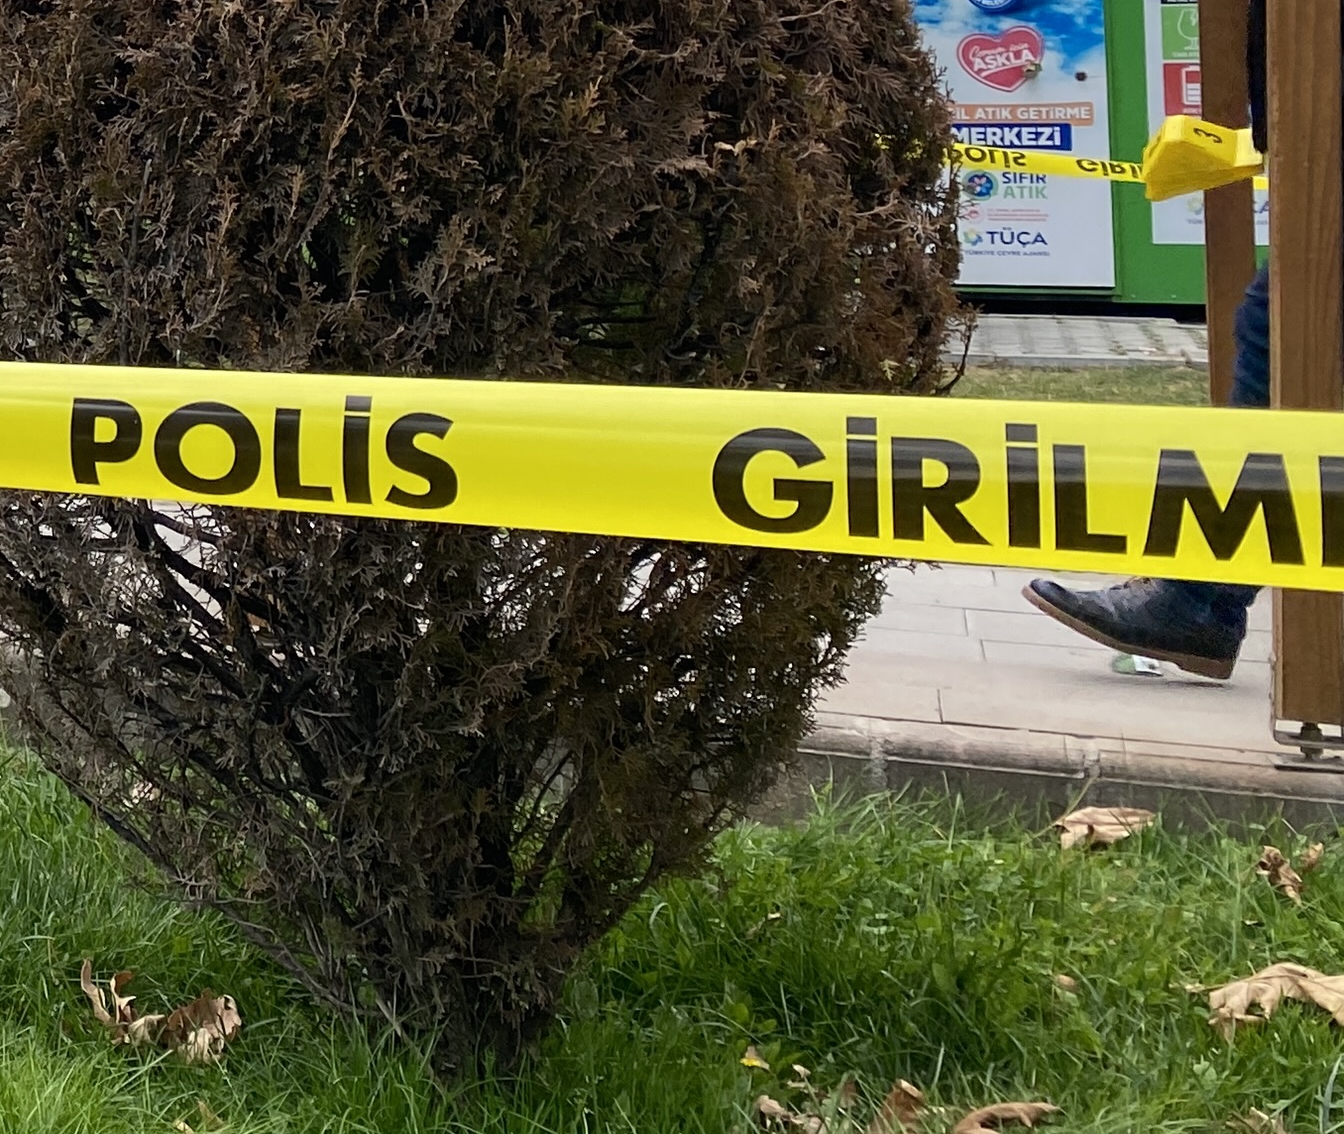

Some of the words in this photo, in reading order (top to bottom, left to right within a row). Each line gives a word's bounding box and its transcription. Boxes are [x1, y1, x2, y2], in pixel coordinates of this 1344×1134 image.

[975, 107, 1013, 120] ATIK
[1017, 105, 1091, 120] GETİRME
[950, 127, 1062, 146] MERKEZİ
[1002, 171, 1047, 184] SIFIR
[1003, 185, 1048, 200] ATIK
[986, 226, 1048, 248] TÜÇA
[69, 395, 459, 510] POLİS
